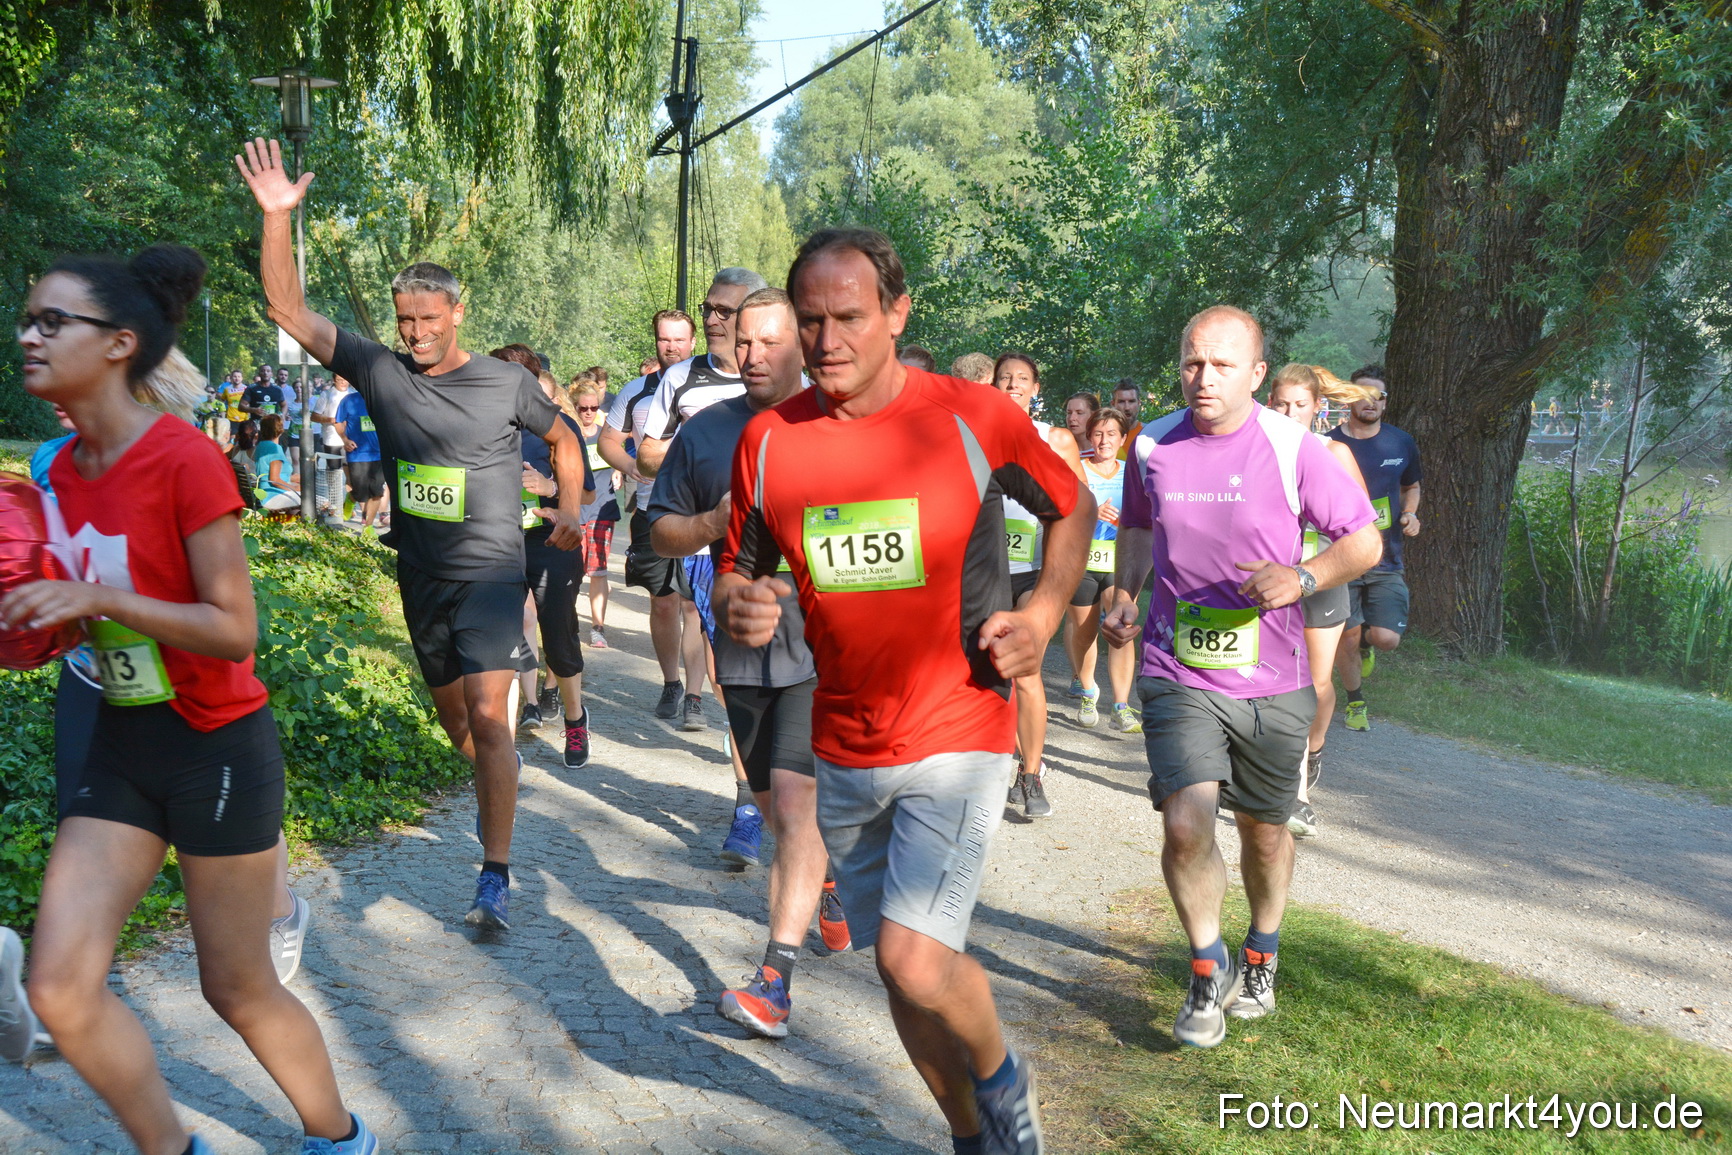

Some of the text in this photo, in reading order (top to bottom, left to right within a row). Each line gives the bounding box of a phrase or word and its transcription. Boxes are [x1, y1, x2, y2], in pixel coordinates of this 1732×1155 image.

[404, 481, 454, 505] 1366
[1164, 492, 1246, 502] WIR SIND LILA.
[819, 532, 904, 567] 1158
[834, 566, 893, 577] Schmid Xaver
[1189, 627, 1239, 652] 682
[966, 804, 990, 859] PORTO
